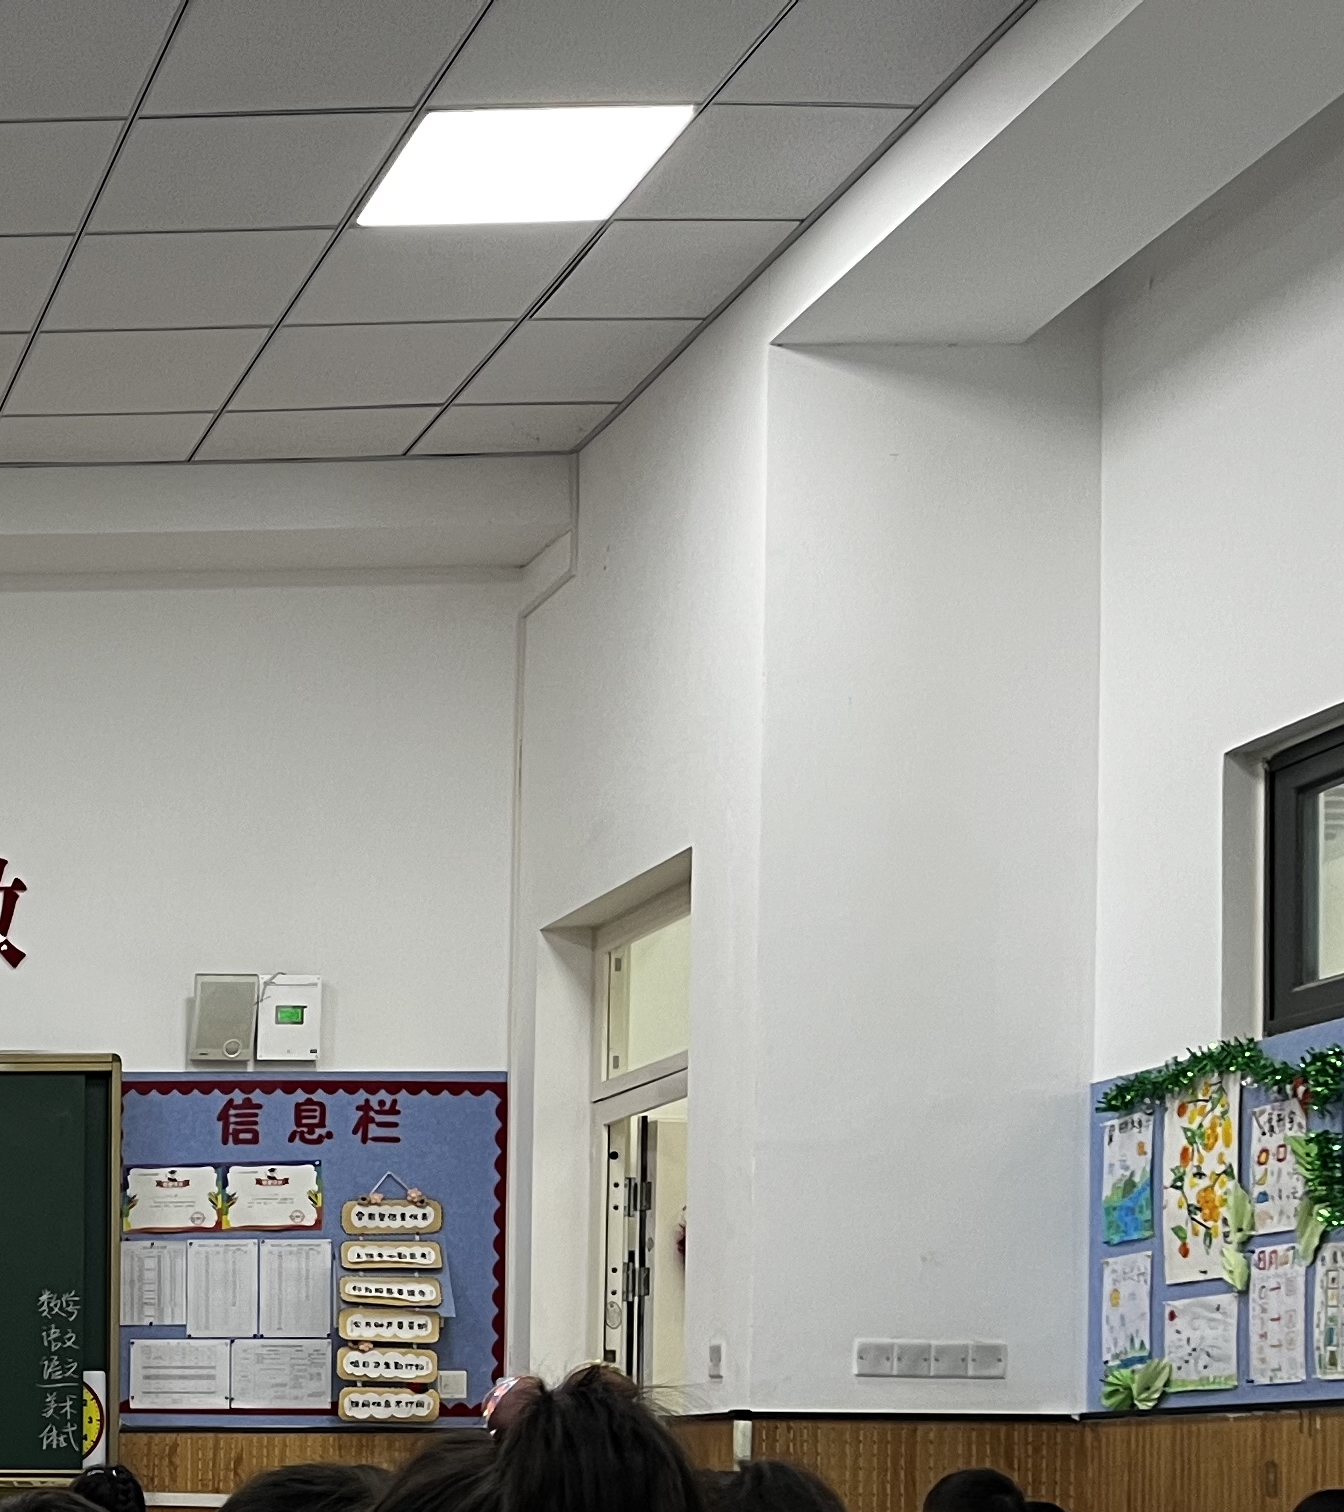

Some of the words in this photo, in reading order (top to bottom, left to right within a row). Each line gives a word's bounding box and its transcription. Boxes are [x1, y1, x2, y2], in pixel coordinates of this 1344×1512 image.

[216, 1097, 402, 1147] 信息栏
[37, 1289, 81, 1322] 数学
[41, 1323, 80, 1352] 语文
[40, 1355, 79, 1380] 语文
[41, 1392, 78, 1419] 美术
